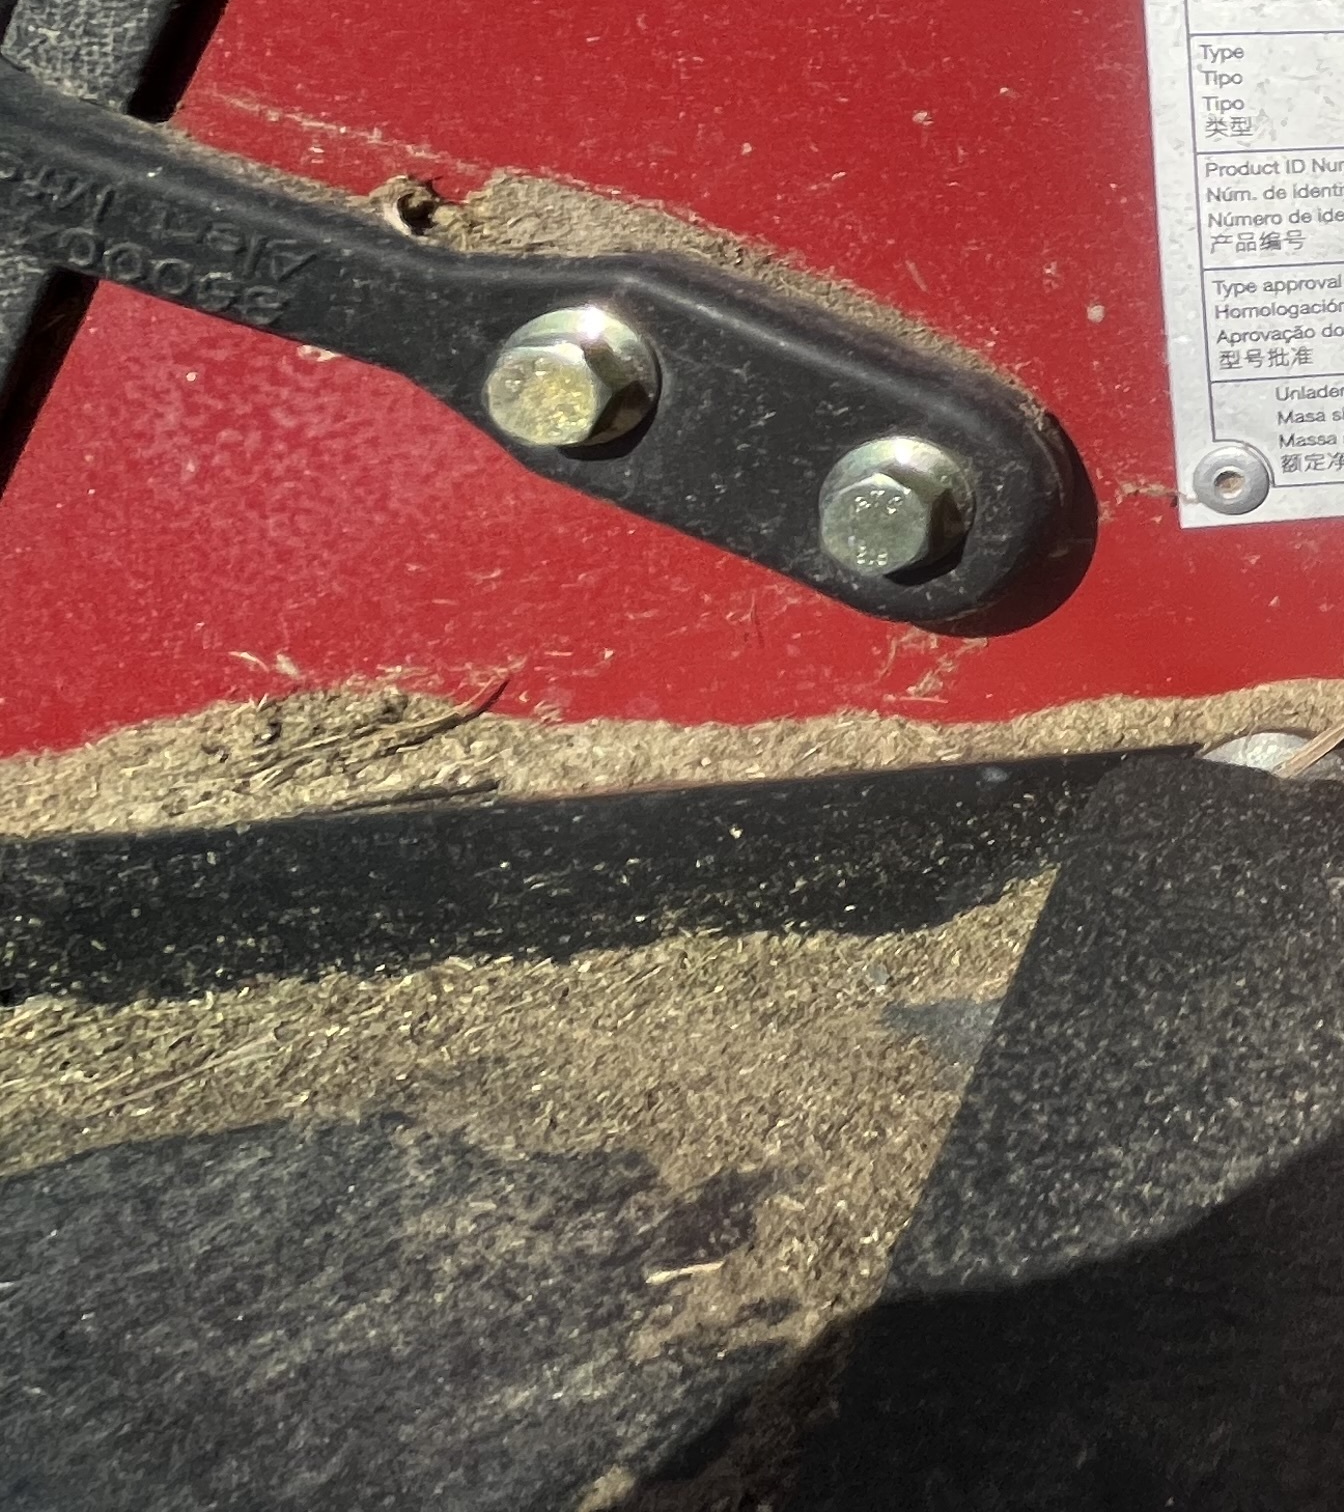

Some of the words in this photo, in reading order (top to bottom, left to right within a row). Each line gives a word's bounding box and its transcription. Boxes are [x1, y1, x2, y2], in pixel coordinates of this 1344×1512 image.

[1201, 44, 1244, 61] Type
[1203, 70, 1242, 88] Tipo
[1203, 95, 1244, 113] Tipo
[1205, 117, 1253, 138] 类型
[1206, 160, 1279, 176] Product
[1285, 159, 1305, 174] ID
[1207, 184, 1258, 203] Núm.
[1264, 185, 1287, 199] de
[1208, 208, 1283, 228] Número
[1289, 210, 1312, 224] de
[1210, 231, 1305, 253] 产品编号
[1213, 278, 1257, 296] Type
[1264, 275, 1342, 294] approval
[1217, 325, 1316, 345] Aprovação
[1322, 323, 1344, 338] do
[1219, 346, 1313, 370] 型号批准
[1278, 409, 1326, 425] Masa
[1279, 432, 1338, 448] Massa
